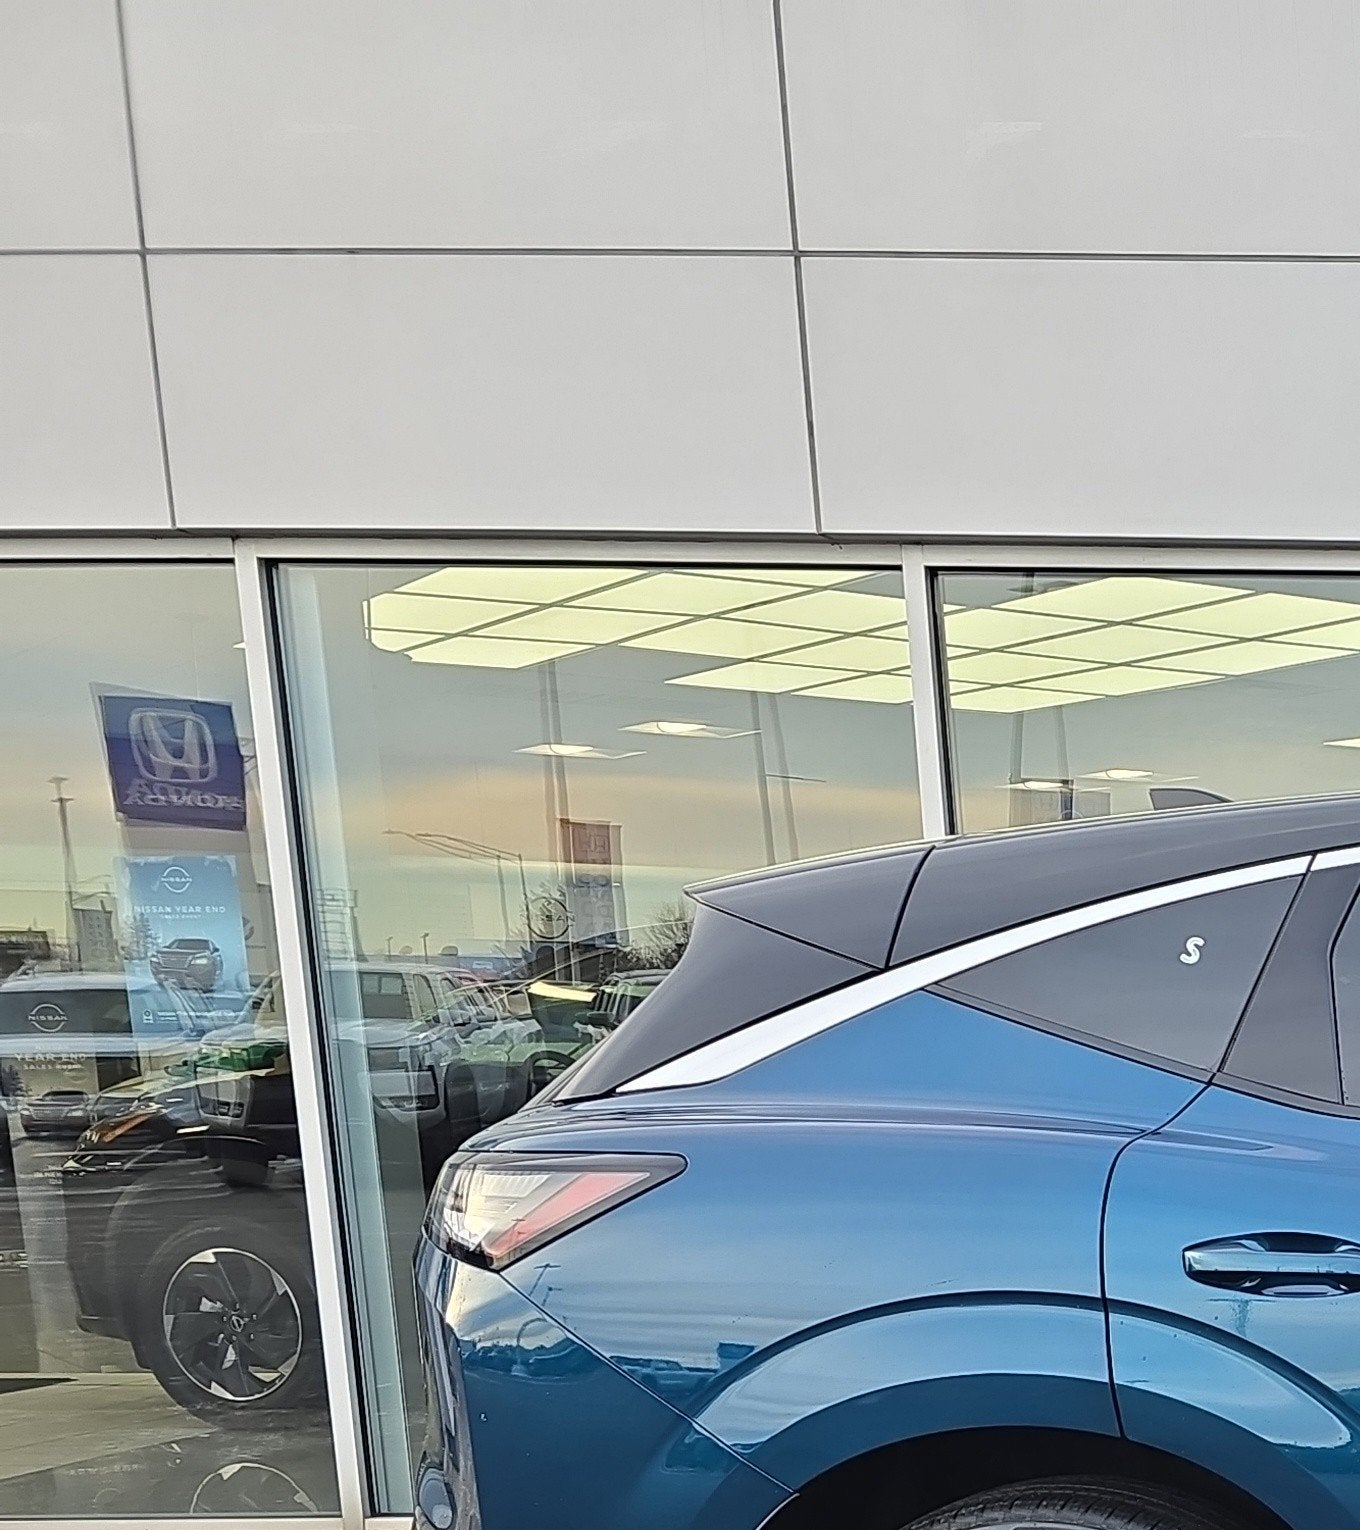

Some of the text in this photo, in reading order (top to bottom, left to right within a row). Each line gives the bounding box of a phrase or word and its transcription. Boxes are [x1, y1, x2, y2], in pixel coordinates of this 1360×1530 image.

[134, 905, 226, 913] NISSAN YEAR END
